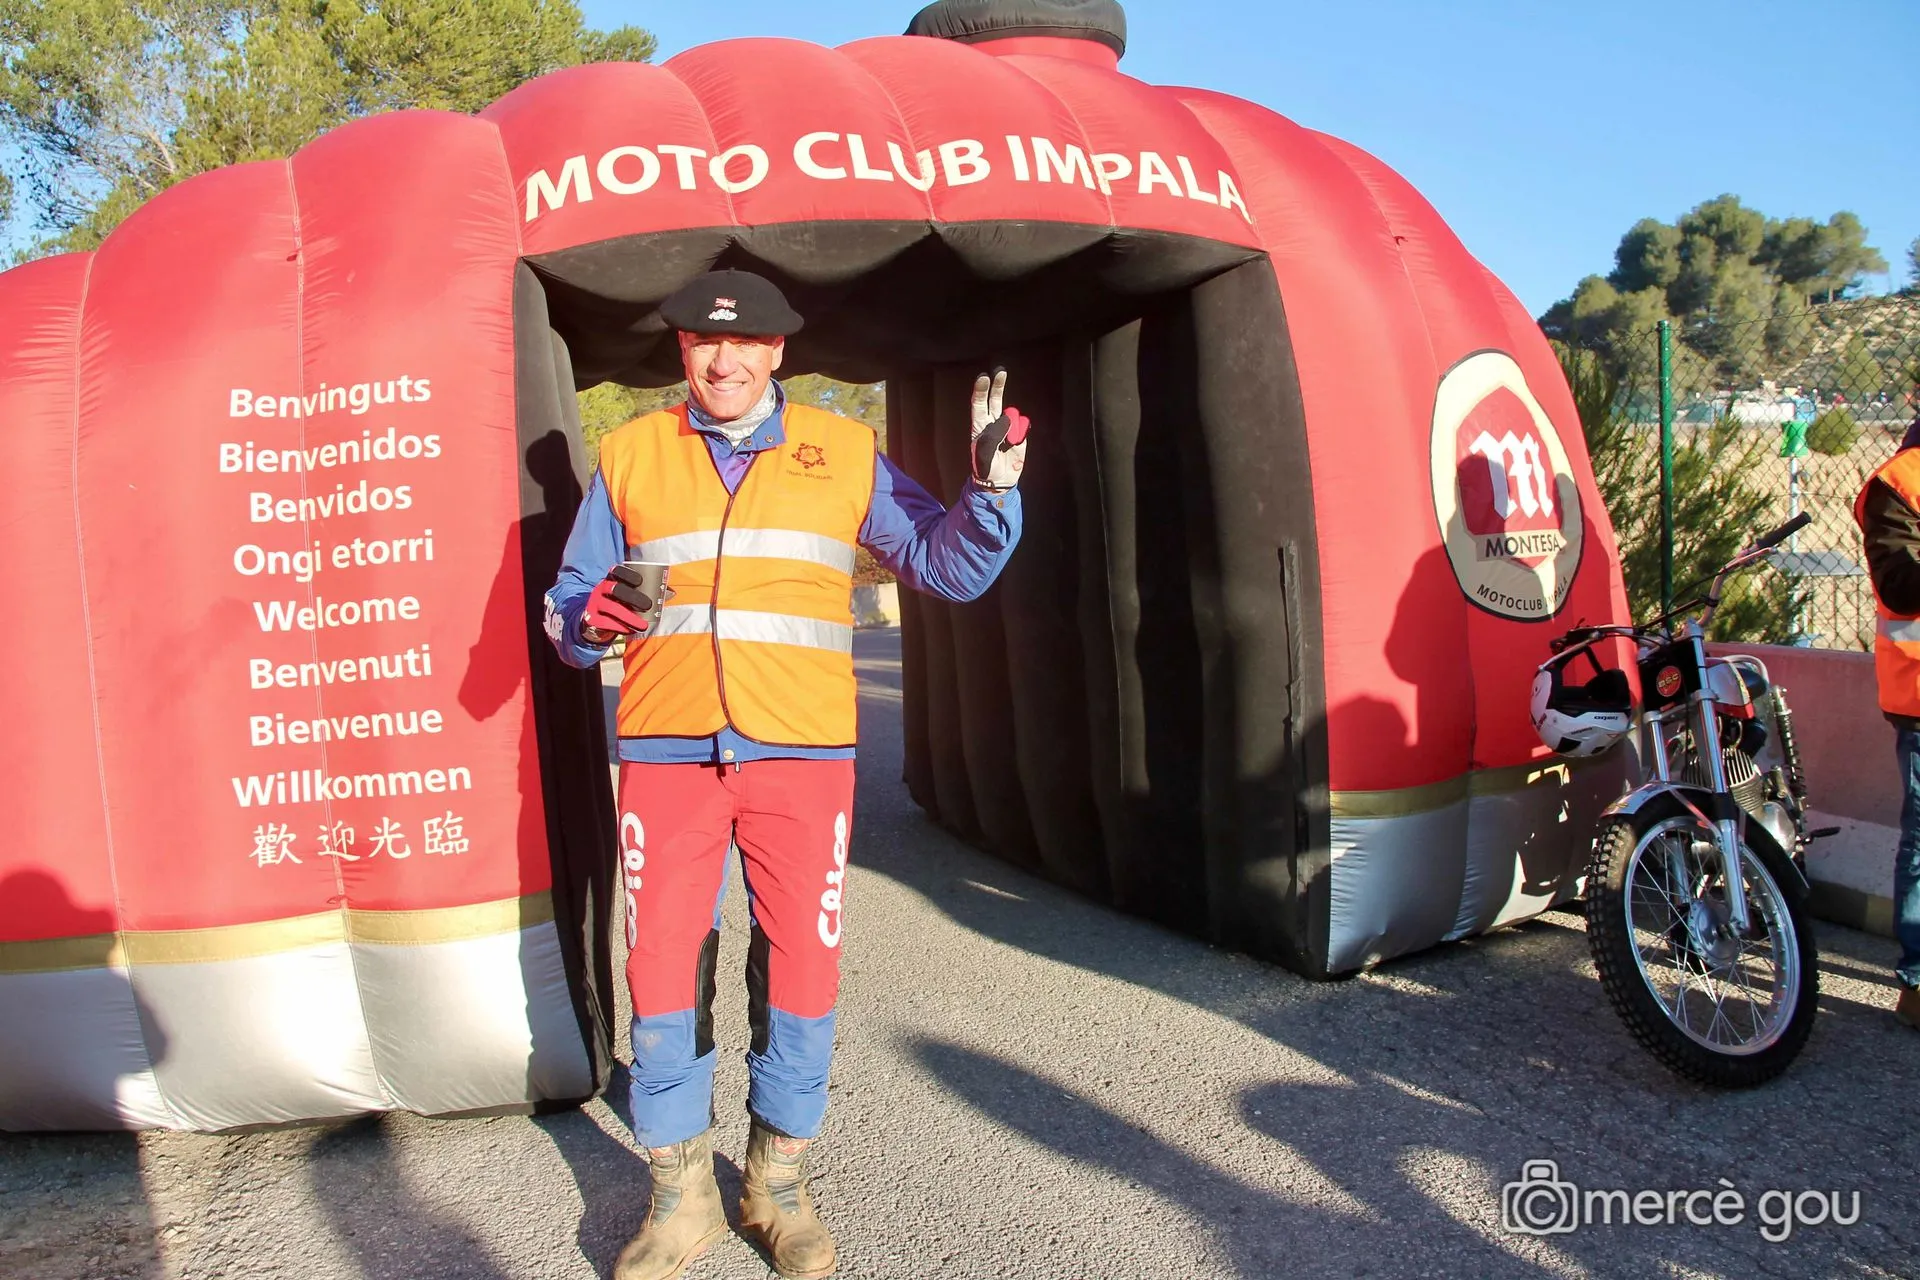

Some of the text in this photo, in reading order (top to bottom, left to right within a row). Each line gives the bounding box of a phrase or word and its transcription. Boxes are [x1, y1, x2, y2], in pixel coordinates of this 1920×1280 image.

[525, 131, 1254, 225] MOTO CLUB IMPALA
[229, 374, 432, 418] Benvinguts
[219, 427, 441, 473] Bienvenidos
[250, 480, 413, 523] Benvidos
[233, 529, 433, 583] Ongi etorri
[1485, 534, 1562, 558] MONTESA
[253, 595, 421, 632] Welcome
[1476, 584, 1543, 611] MOTOCLUB
[249, 643, 433, 690] Benvenuti
[249, 707, 443, 747] Bienvenue
[231, 765, 472, 808] Willkommen
[249, 810, 470, 868] 歡迎光臨
